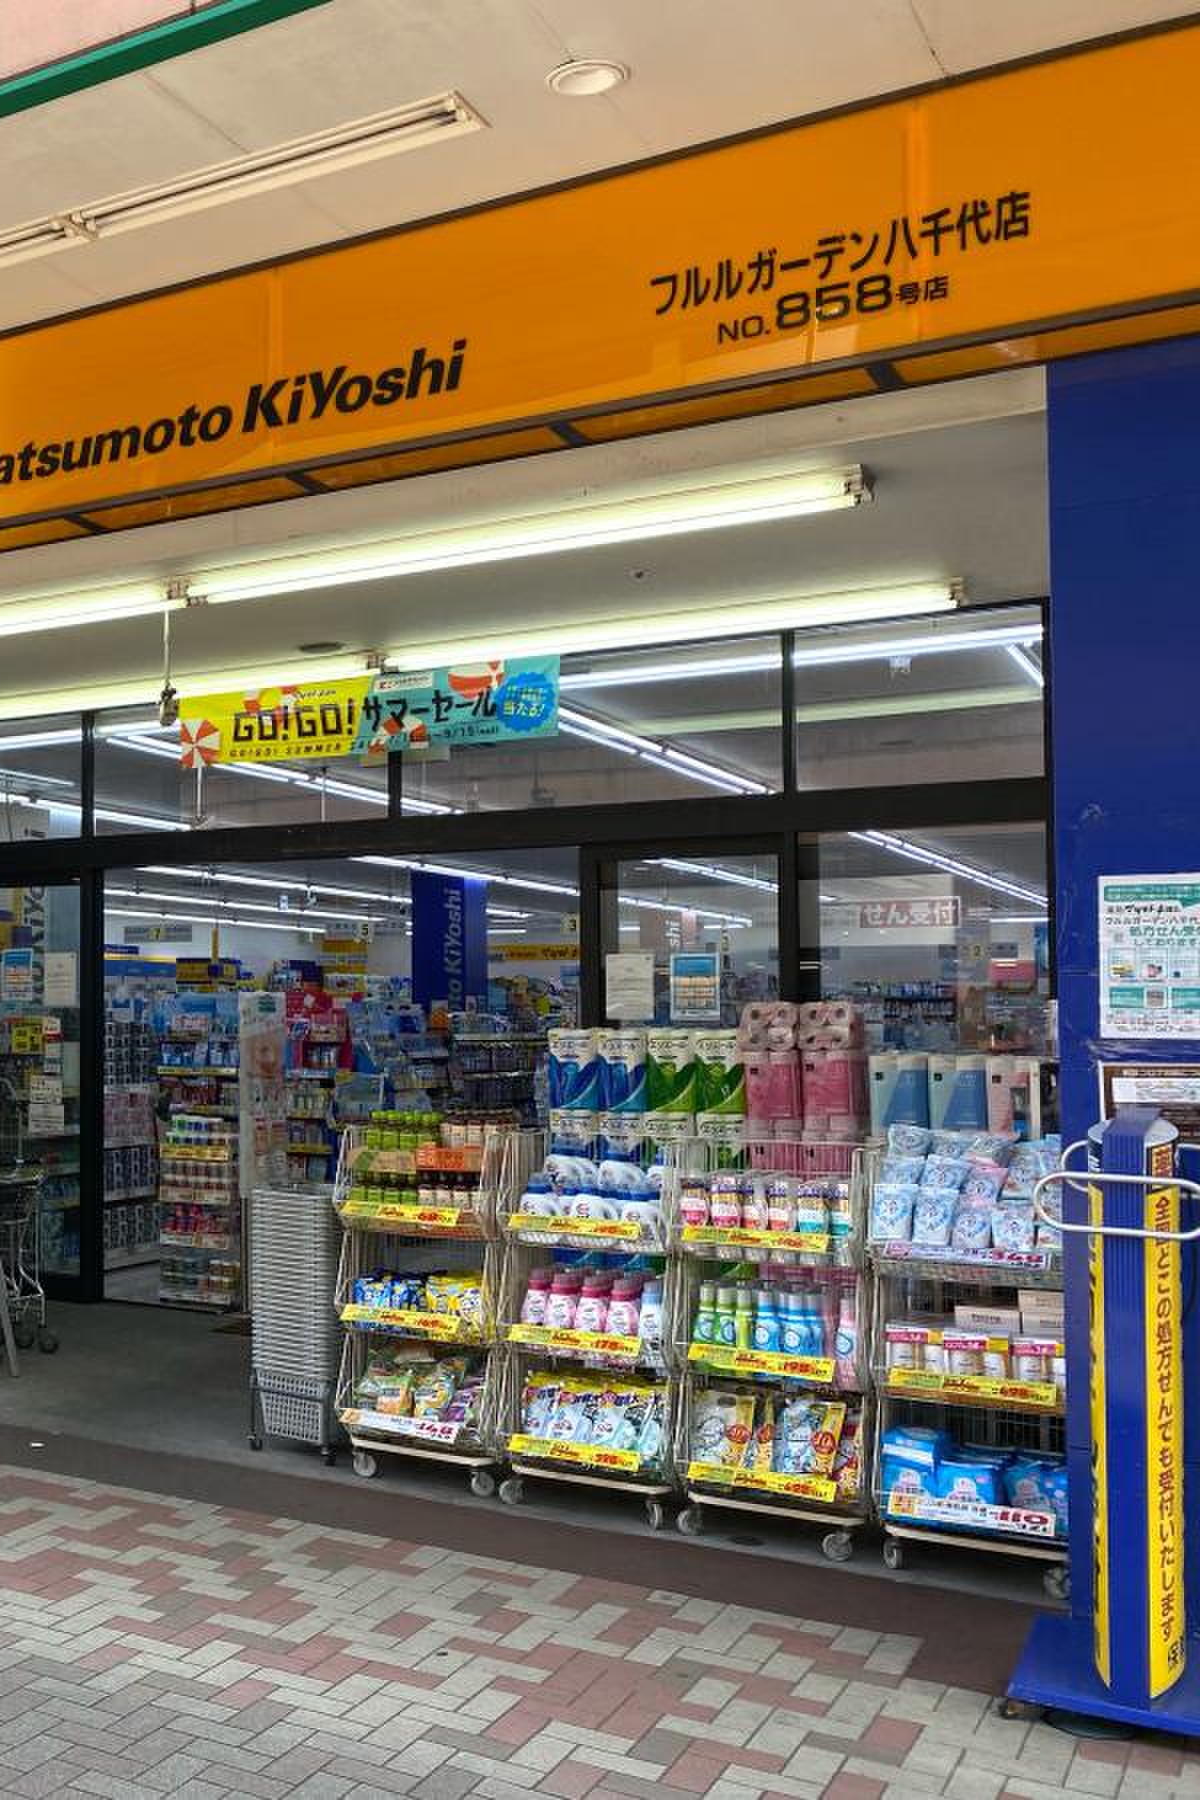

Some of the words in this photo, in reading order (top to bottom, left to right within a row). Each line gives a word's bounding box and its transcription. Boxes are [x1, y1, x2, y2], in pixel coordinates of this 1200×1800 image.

[650, 192, 1030, 315] フルルガーデン八千代店
[242, 340, 466, 432] KiYoshi
[362, 685, 497, 732] サマーセール
